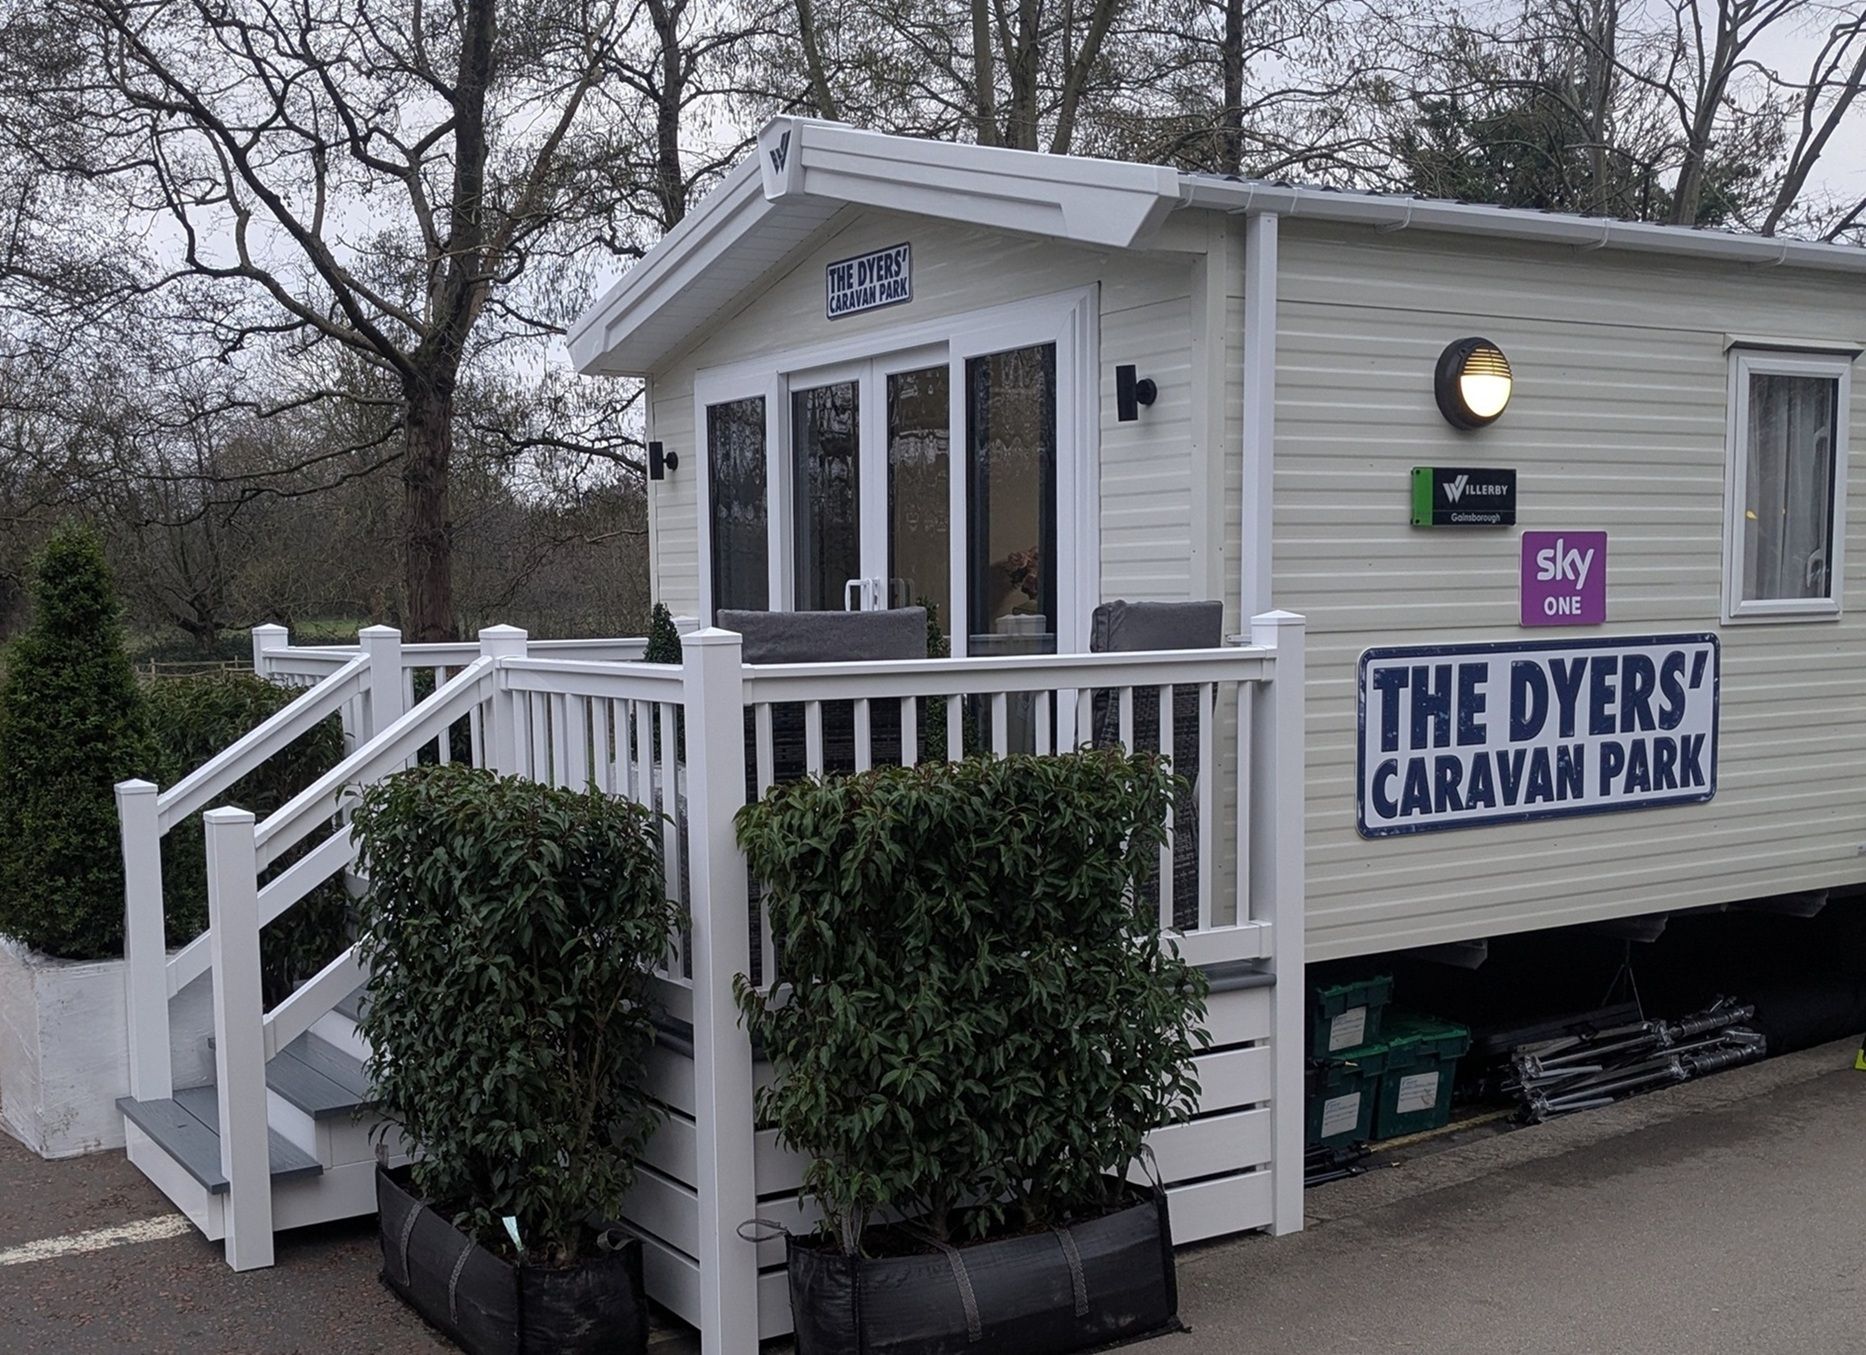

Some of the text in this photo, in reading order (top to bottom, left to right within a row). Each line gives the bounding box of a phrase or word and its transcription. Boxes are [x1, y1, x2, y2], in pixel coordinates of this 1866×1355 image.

[829, 248, 907, 294] THE DYERS'
[830, 276, 907, 314] CARAVAN PARK
[1443, 475, 1508, 503] WILLERBY
[1451, 512, 1501, 524] Gainsborough
[1536, 538, 1595, 590] sky
[1543, 596, 1582, 616] ONE
[1373, 650, 1709, 752] THE DYERS'
[1372, 733, 1706, 819] CARAVAN PARK
